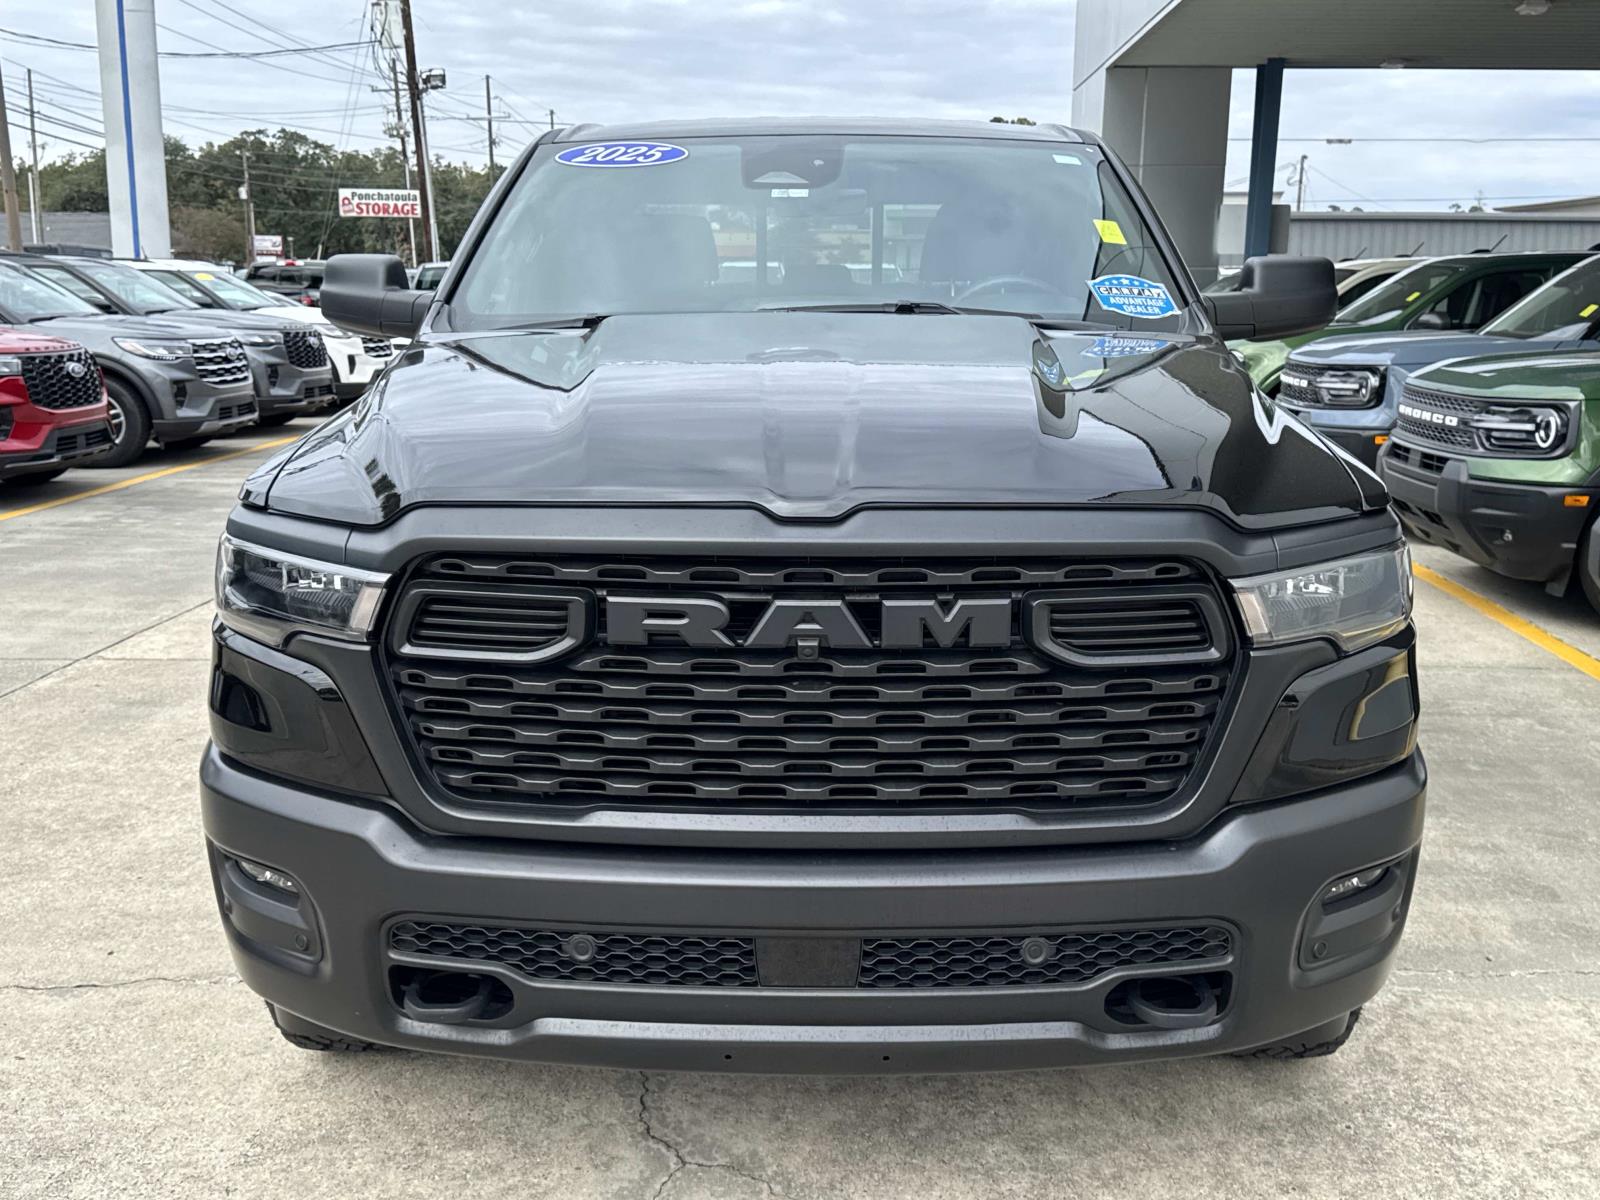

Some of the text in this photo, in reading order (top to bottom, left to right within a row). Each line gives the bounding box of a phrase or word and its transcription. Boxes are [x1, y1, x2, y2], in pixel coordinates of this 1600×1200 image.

[571, 146, 672, 162] 2025
[351, 192, 417, 202] Ponchatoula
[356, 203, 418, 216] STORAGE
[1110, 297, 1166, 307] ADVANTAGE
[1123, 305, 1161, 314] DEALER
[1399, 404, 1458, 426] BRONCO
[607, 596, 1011, 648] RAM
